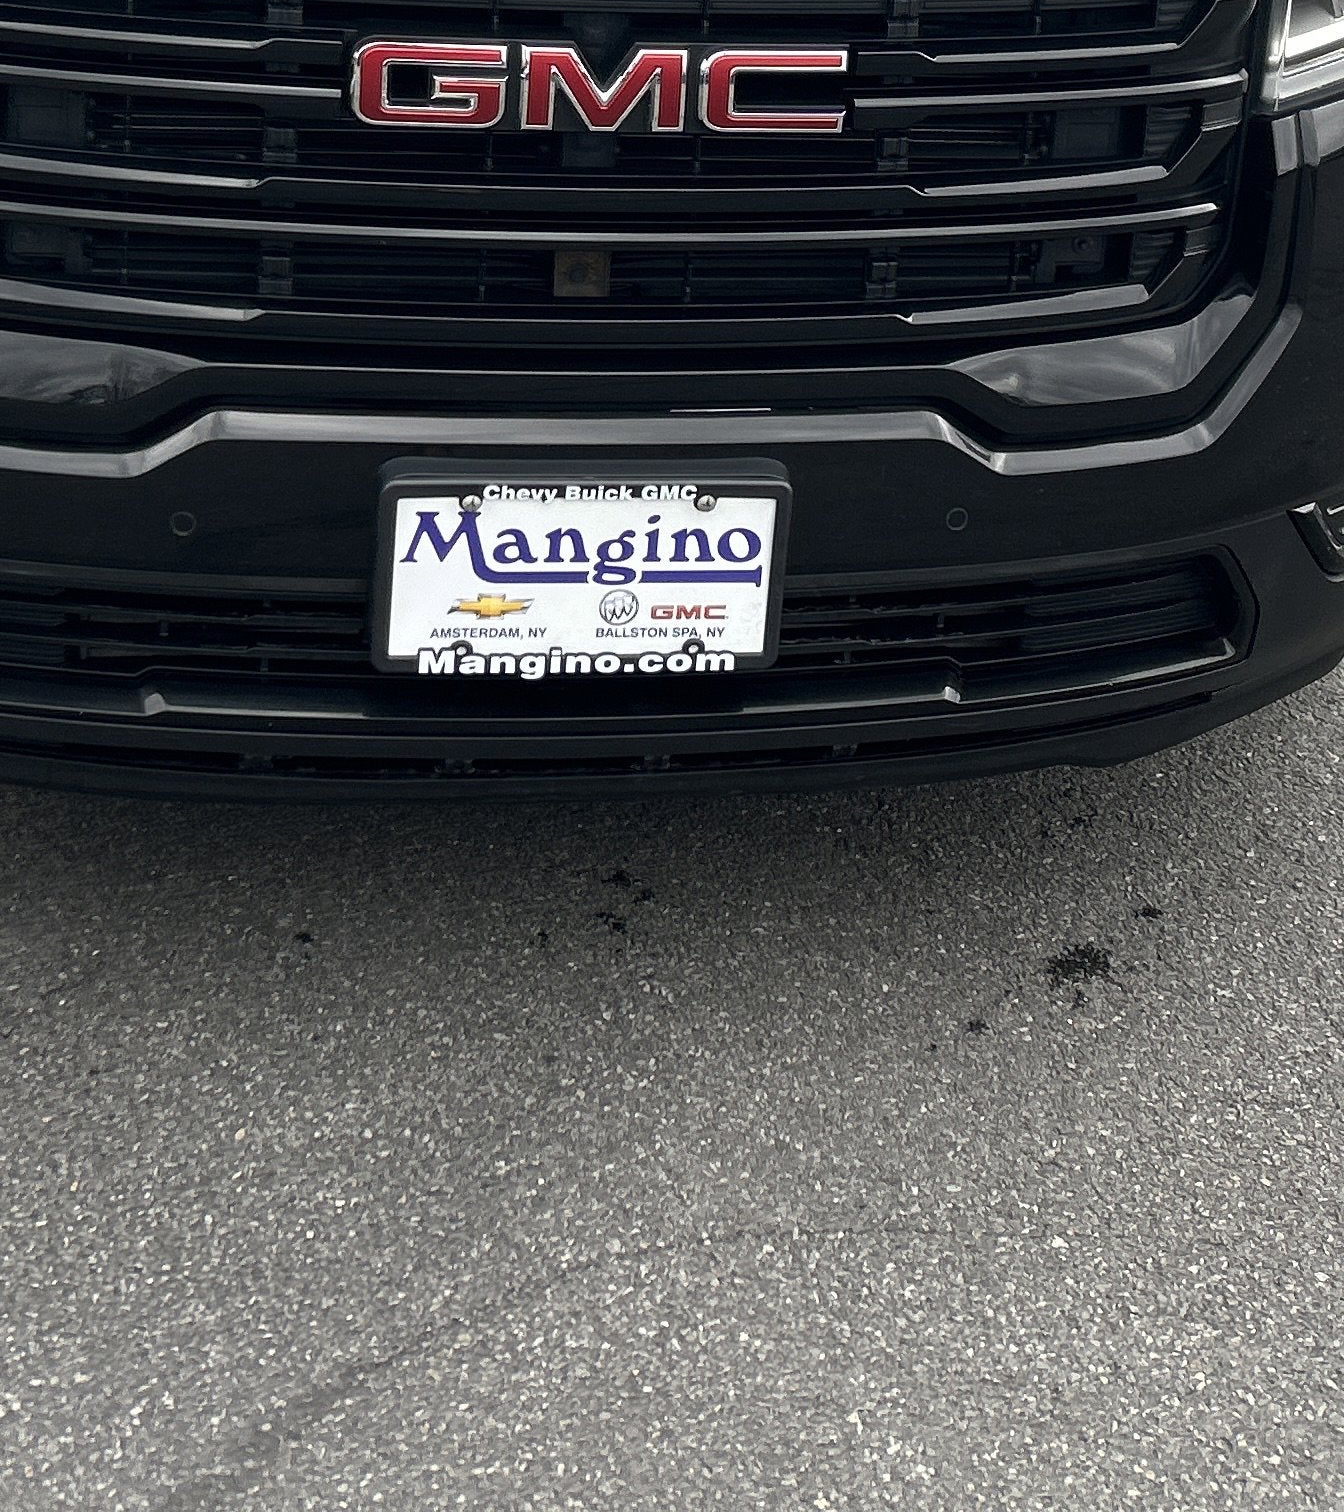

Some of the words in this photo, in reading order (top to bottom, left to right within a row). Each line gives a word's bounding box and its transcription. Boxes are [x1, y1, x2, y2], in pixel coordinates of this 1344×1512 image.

[352, 42, 849, 133] GMC
[483, 484, 558, 503] Chevy
[565, 484, 633, 501] Buick
[641, 484, 698, 501] GMC
[399, 510, 763, 587] Mangino
[650, 605, 727, 620] GMC
[430, 627, 524, 640] AMSTERDAM,
[528, 627, 548, 638] NY
[596, 627, 668, 638] BALLSTON
[672, 627, 702, 640] SPA,
[706, 627, 726, 638] NY
[418, 646, 735, 680] Mangino.com
